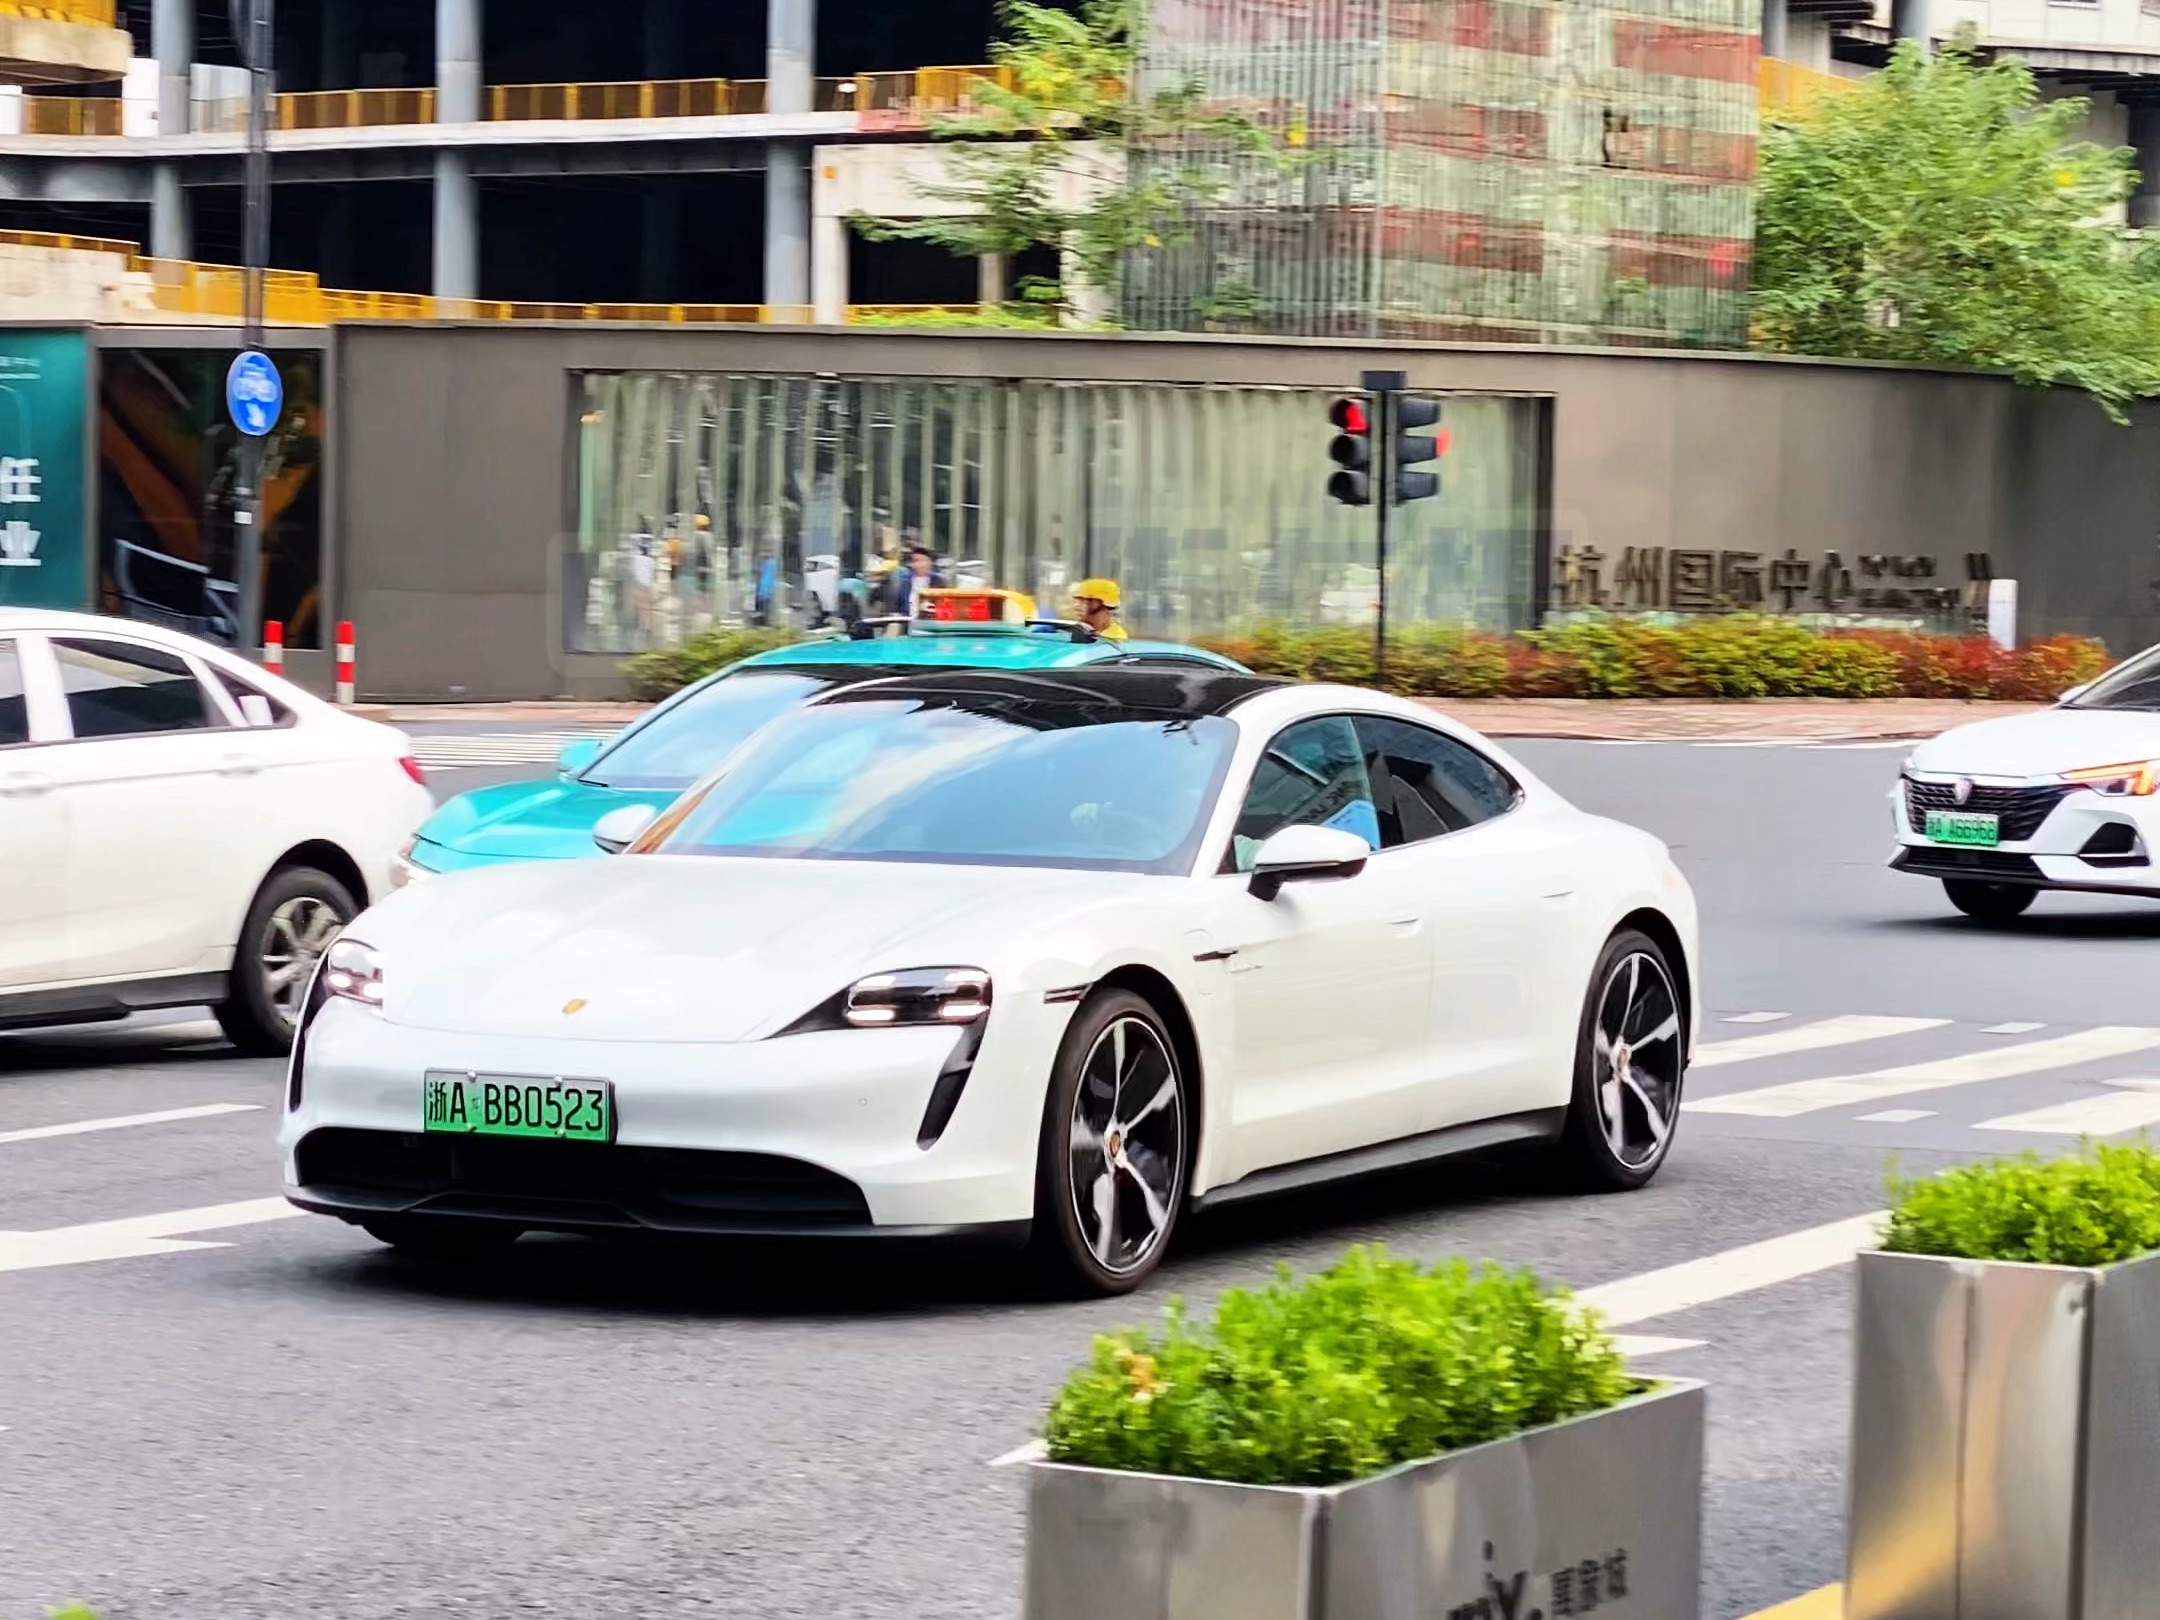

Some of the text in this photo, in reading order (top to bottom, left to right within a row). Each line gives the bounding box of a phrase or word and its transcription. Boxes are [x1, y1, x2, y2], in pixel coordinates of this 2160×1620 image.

[0, 520, 42, 567] 业
[1553, 545, 1853, 612] 杭州国际中心
[429, 1081, 604, 1131] 浙A BB0523
